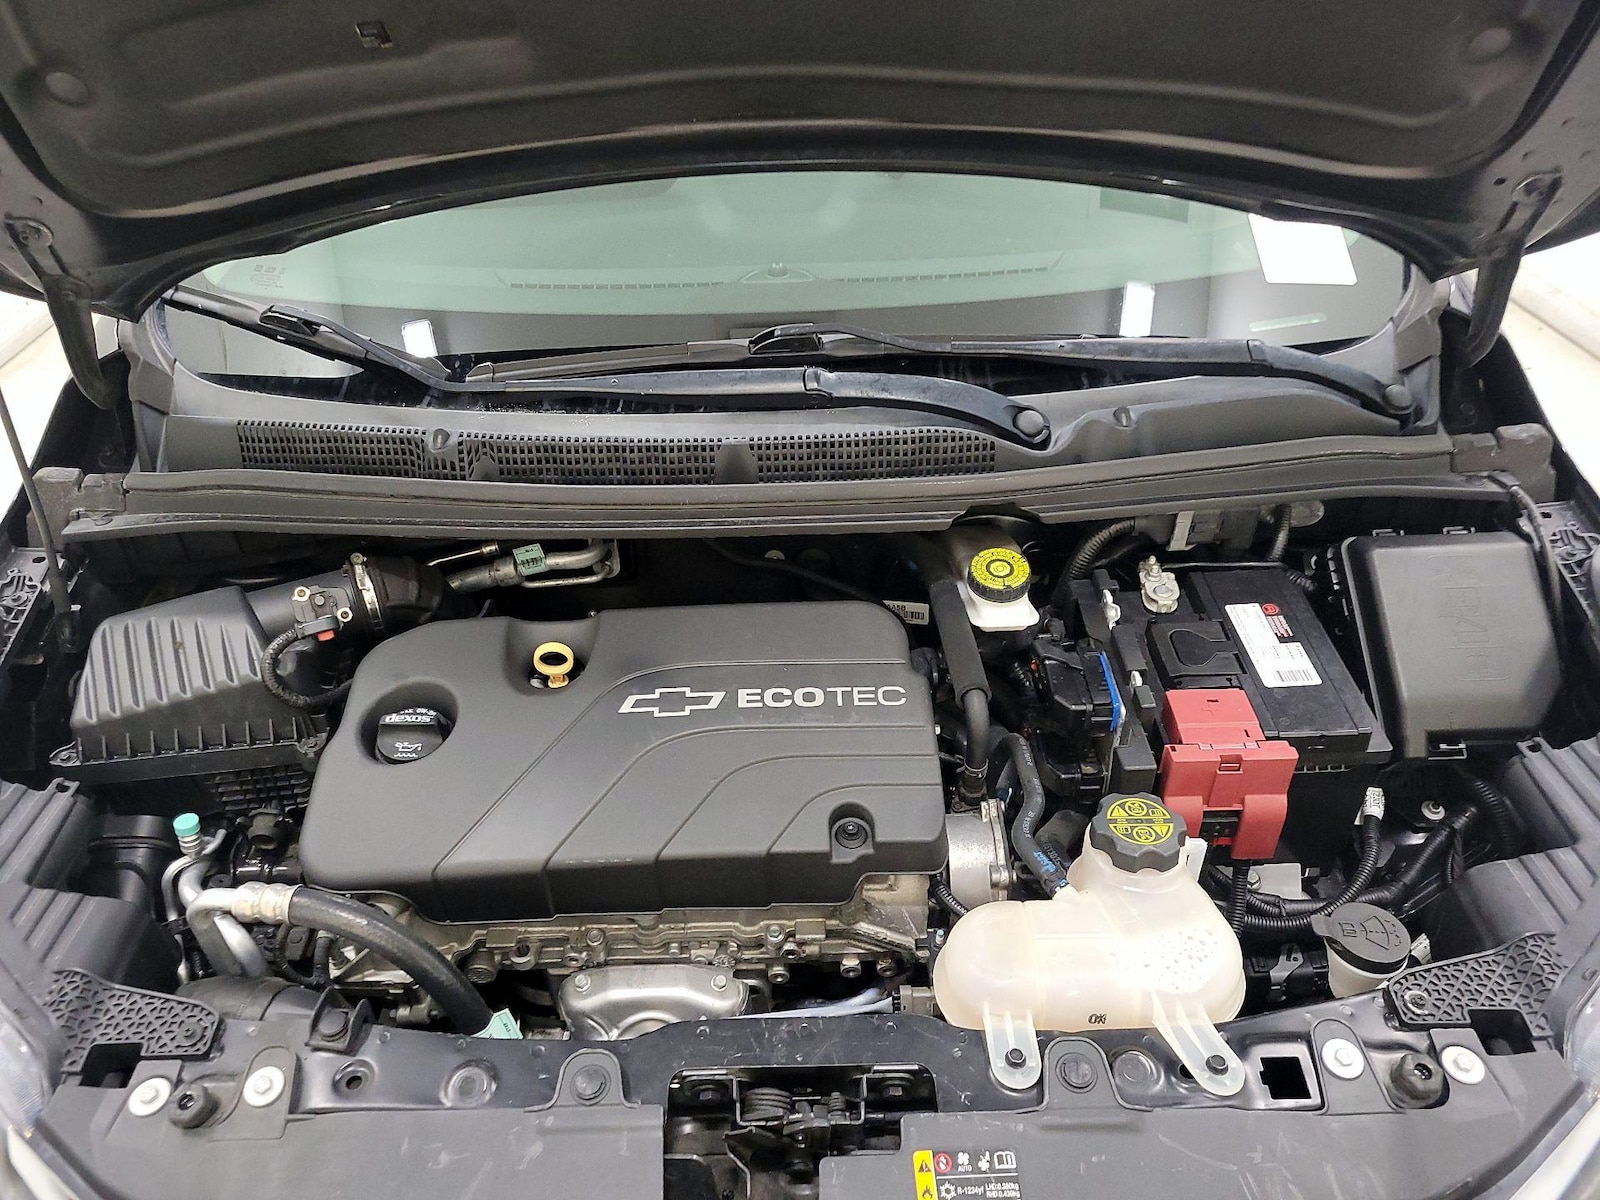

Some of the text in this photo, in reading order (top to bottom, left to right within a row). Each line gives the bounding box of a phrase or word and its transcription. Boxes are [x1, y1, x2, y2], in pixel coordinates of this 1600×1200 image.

[738, 686, 907, 709] ECOTEC
[385, 713, 434, 723] dexos
[958, 1164, 973, 1172] AUTO
[957, 1185, 984, 1196] R-1234yf
